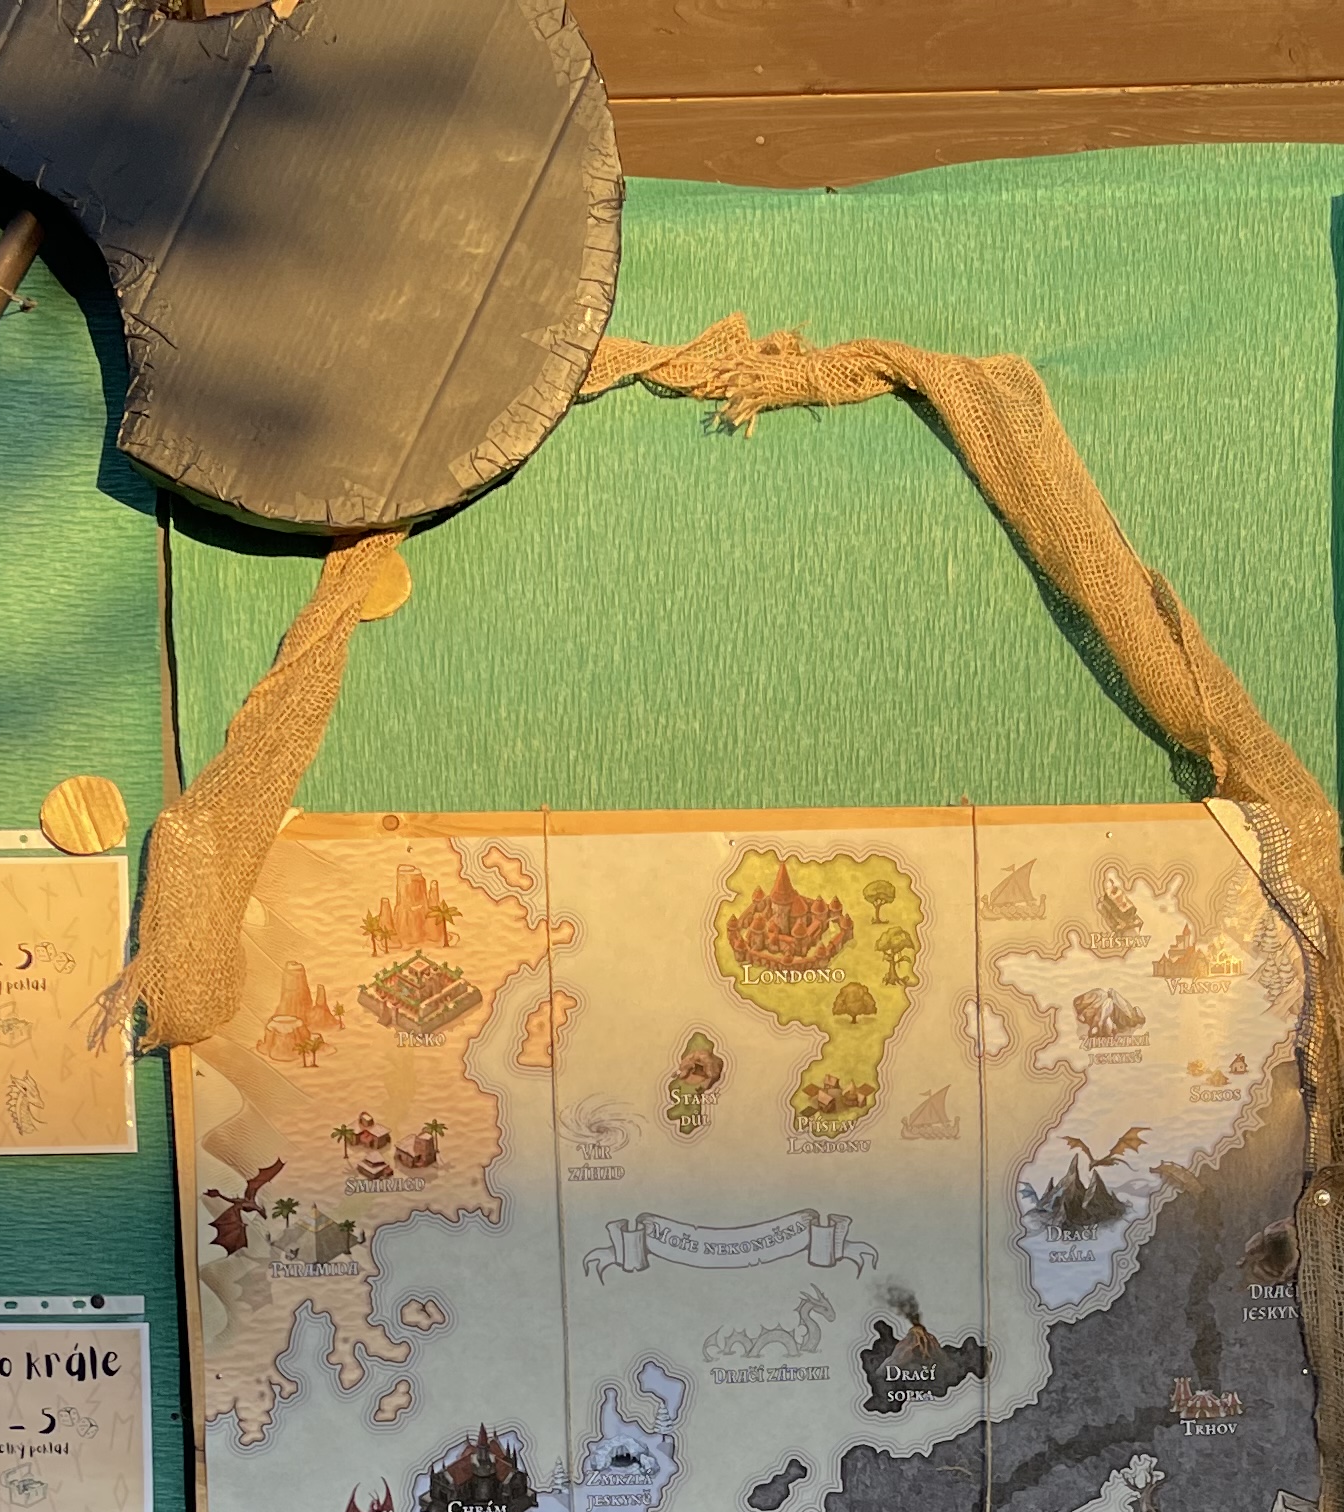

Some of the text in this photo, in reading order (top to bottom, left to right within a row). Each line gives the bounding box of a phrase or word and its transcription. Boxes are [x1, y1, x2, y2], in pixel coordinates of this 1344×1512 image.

[15, 943, 33, 970] 5
[6, 978, 47, 994] poklad
[26, 1343, 122, 1381] krále
[39, 1407, 56, 1434] 5
[29, 1442, 69, 1458] poklad
